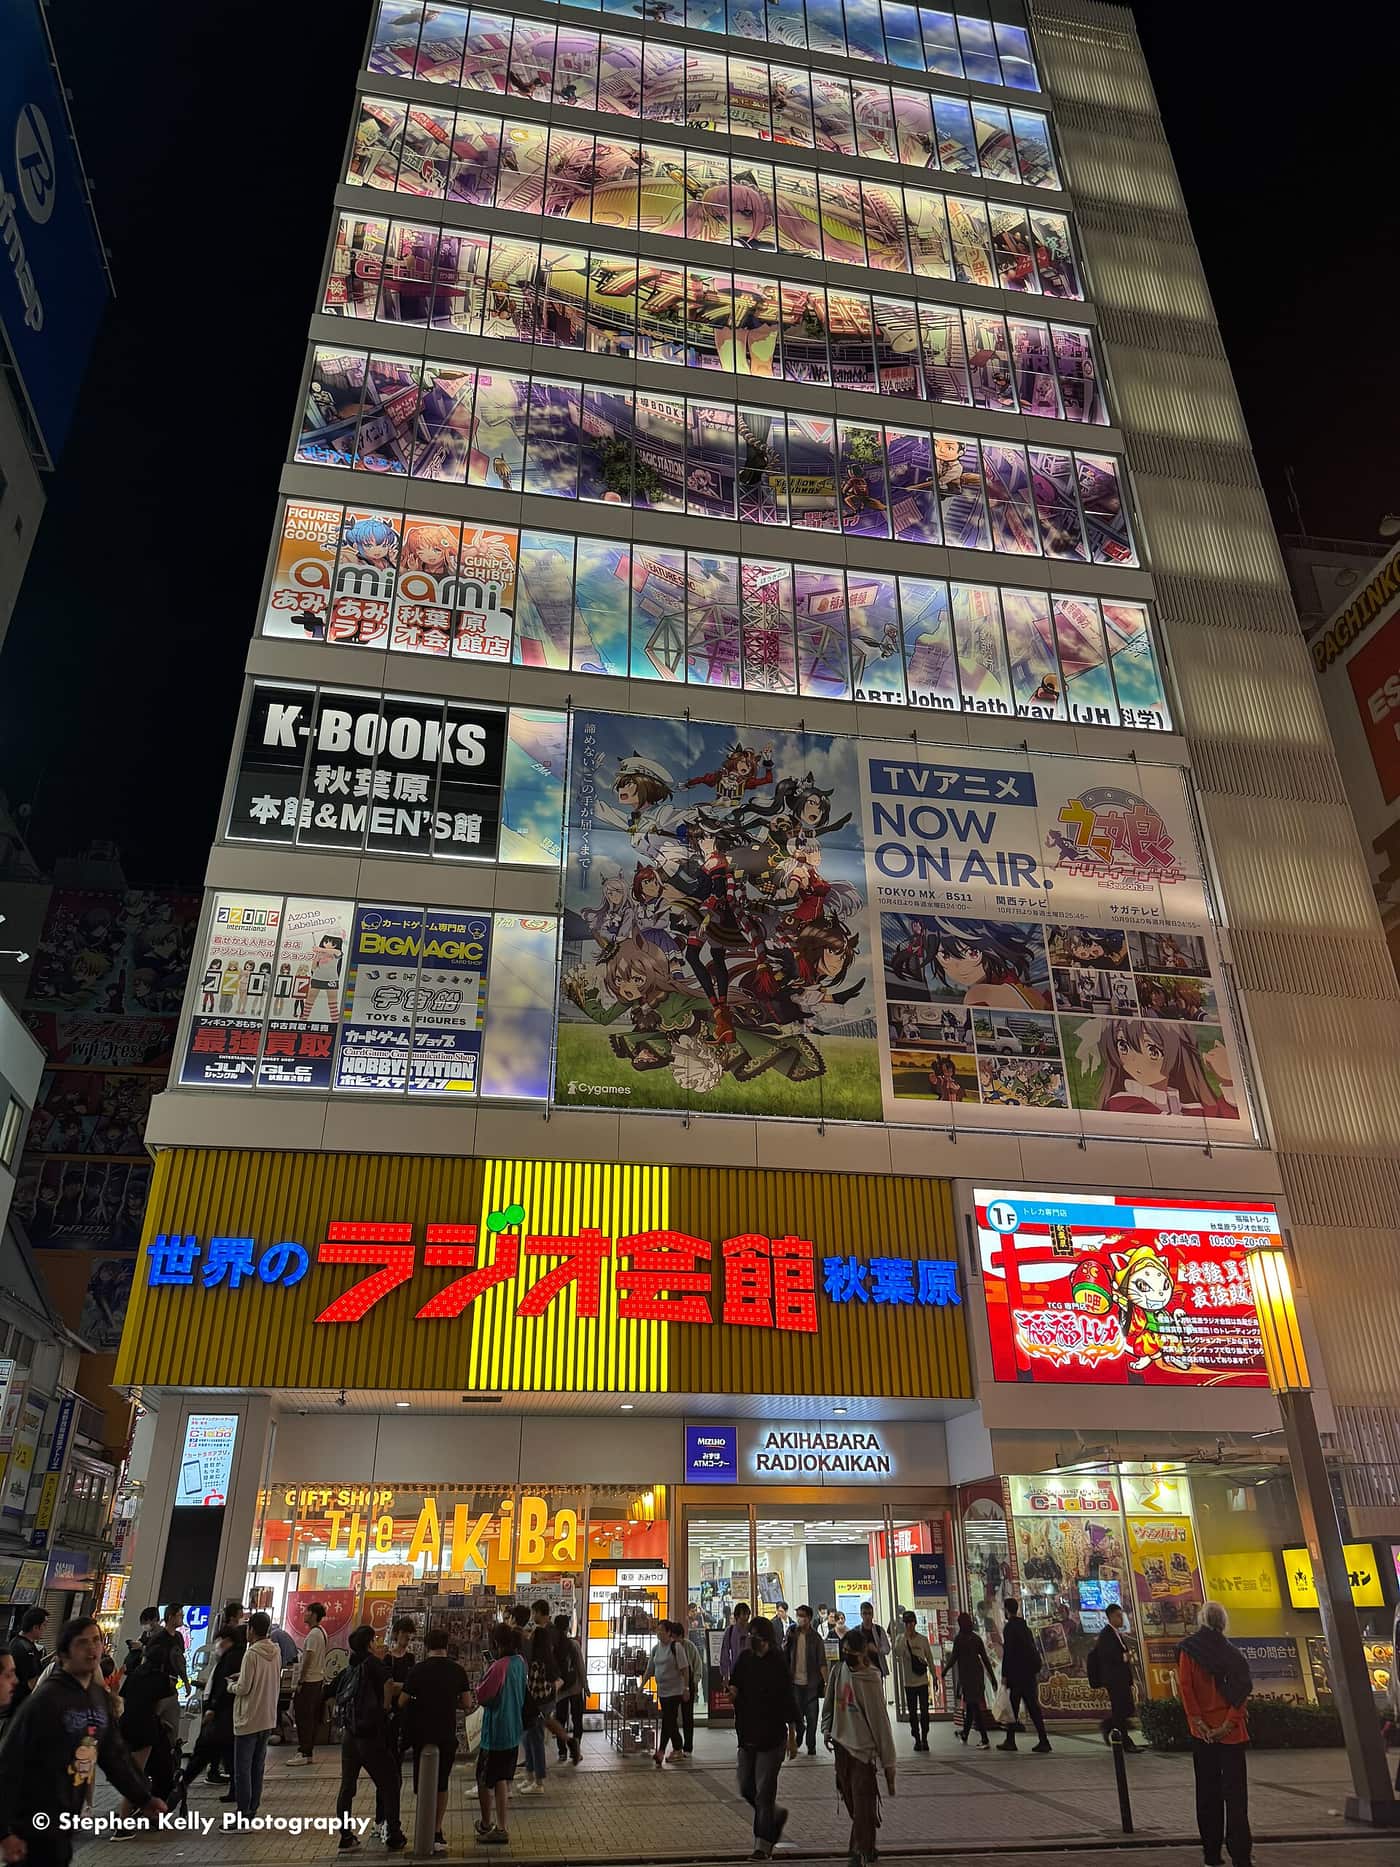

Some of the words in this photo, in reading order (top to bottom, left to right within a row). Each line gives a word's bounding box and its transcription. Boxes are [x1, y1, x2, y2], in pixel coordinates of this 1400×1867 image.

[287, 507, 340, 523] FIGURES
[285, 519, 337, 534] ANIME
[284, 529, 337, 544] GOODS
[464, 556, 514, 571] GUNPLA
[332, 618, 509, 656] ラジオ会館店
[908, 690, 955, 709] John
[262, 703, 487, 767] K-BOOKS
[313, 764, 431, 802] 秋葉原
[883, 766, 1020, 799] TVアニメ
[872, 802, 997, 844] NOW
[875, 842, 951, 882] ON
[959, 851, 1054, 890] AIR.
[877, 886, 916, 898] TOKYO
[919, 890, 936, 900] MX
[946, 892, 973, 902] BS11
[995, 895, 1048, 908] 関西テレビ
[216, 907, 280, 927] azone
[288, 909, 321, 922] Azone
[1110, 904, 1160, 917] サガテレビ
[288, 917, 336, 931] Labelshop
[366, 1013, 397, 1022] TOYS
[416, 1016, 466, 1025] FIGURES
[192, 1028, 333, 1057] 最強買取
[205, 1061, 313, 1076] JUNGLE
[578, 1083, 632, 1095] Cygames
[993, 1207, 1015, 1225] 1F
[1024, 1207, 1068, 1217] トレカ専門店
[147, 1234, 309, 1288] 世界の
[314, 1204, 819, 1334] ラジオ会館
[823, 1256, 962, 1306] 秋葉原
[698, 1437, 726, 1445] MIZUHO
[765, 1432, 880, 1450] AKIHABARA
[693, 1460, 730, 1468] ATMコーナー
[702, 1452, 721, 1460] みずほ
[757, 1453, 890, 1472] RADIOKAIKAN
[285, 1490, 329, 1506] GIFT
[337, 1490, 393, 1506] SHOP
[1030, 1495, 1112, 1511] C-labo
[324, 1510, 394, 1558] The
[190, 1607, 208, 1625] 1F
